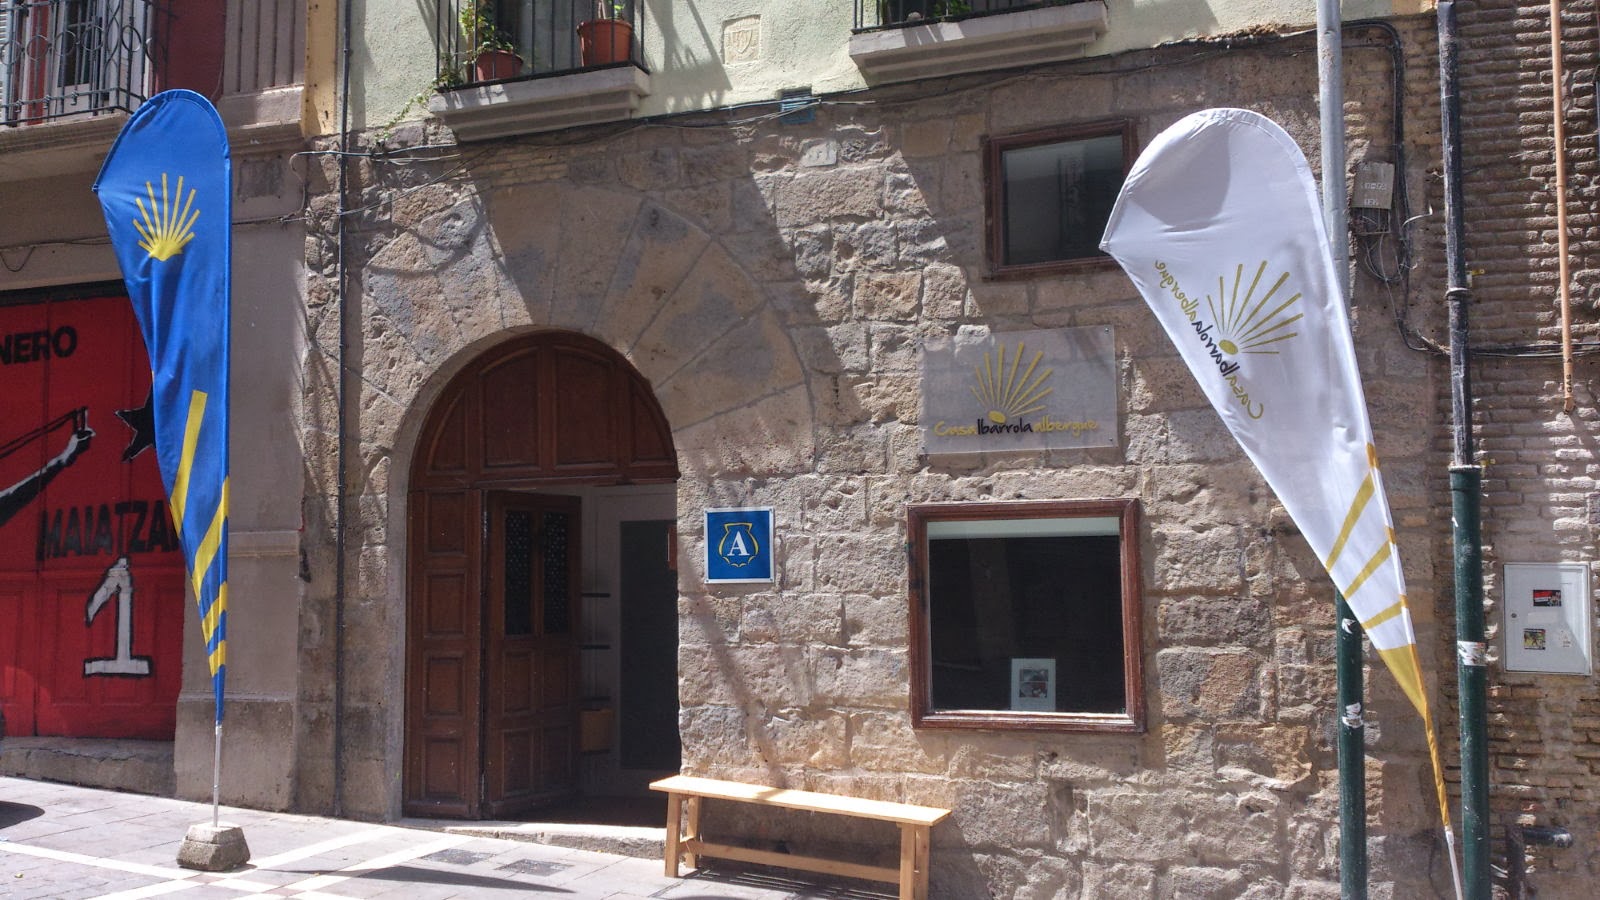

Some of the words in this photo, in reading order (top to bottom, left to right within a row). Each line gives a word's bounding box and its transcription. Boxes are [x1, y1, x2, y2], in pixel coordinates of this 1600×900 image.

[36, 500, 180, 561] MAIATZA
[727, 530, 750, 556] A
[84, 555, 153, 679] 1
